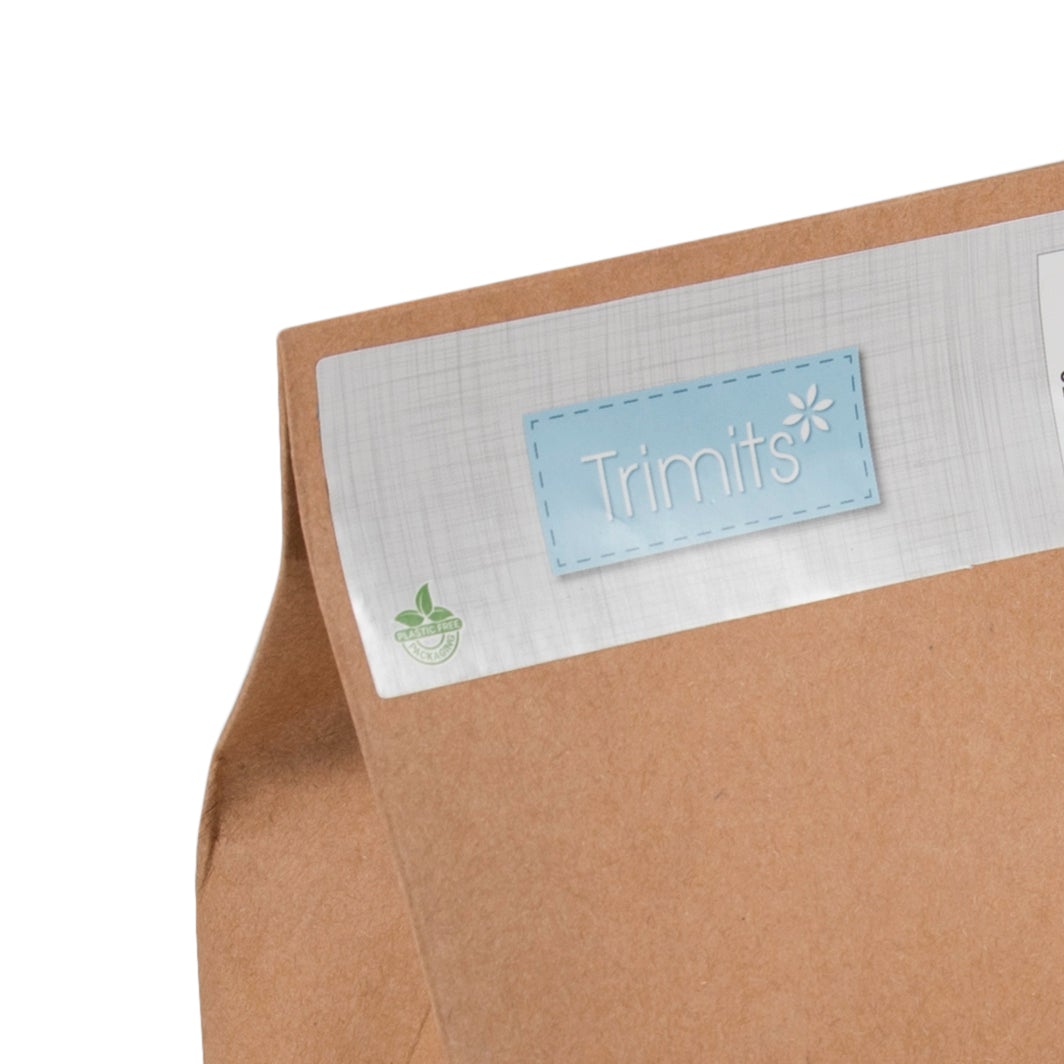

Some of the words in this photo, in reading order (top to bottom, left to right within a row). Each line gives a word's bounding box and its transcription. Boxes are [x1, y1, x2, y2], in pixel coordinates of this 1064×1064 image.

[580, 421, 801, 521] Trimits
[397, 625, 437, 640] PLASTIC
[437, 620, 460, 632] FREE
[408, 634, 456, 661] PACKAGING
